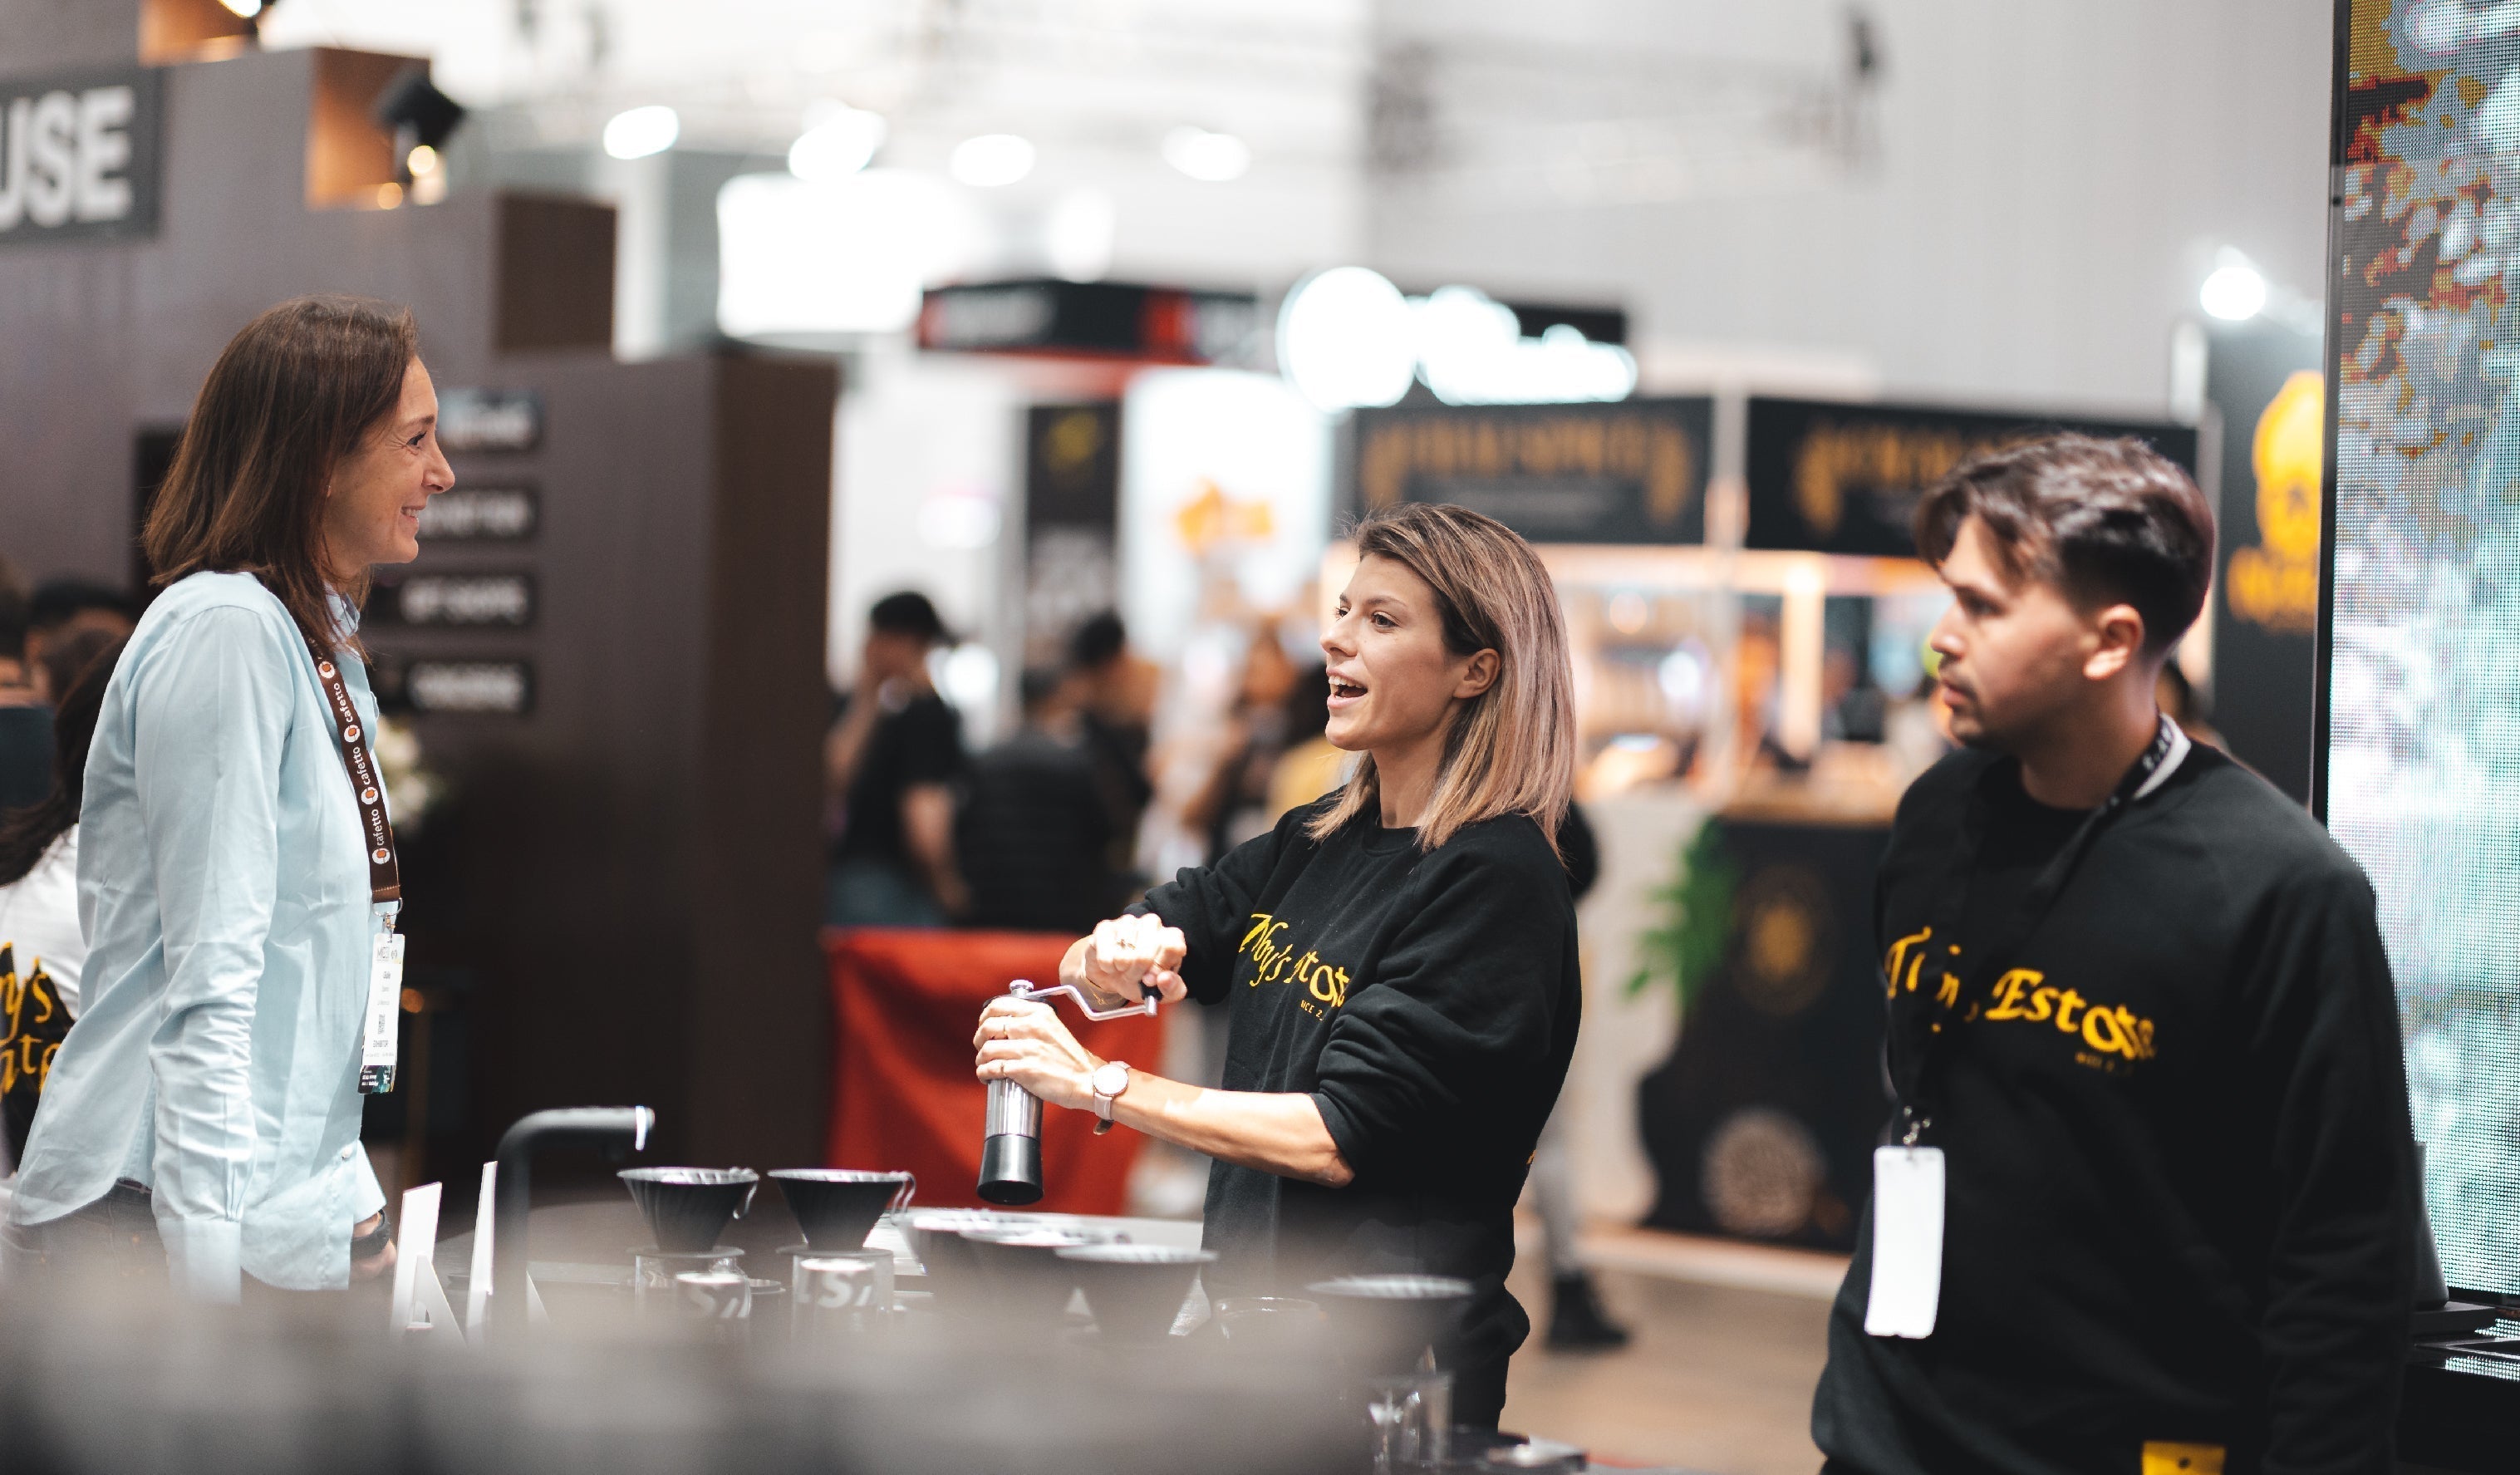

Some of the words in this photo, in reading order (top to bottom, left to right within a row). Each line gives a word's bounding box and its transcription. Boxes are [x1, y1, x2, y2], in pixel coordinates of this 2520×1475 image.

[333, 682, 353, 722] cafetto
[352, 746, 371, 785] cafetto
[371, 809, 385, 846] cafetto
